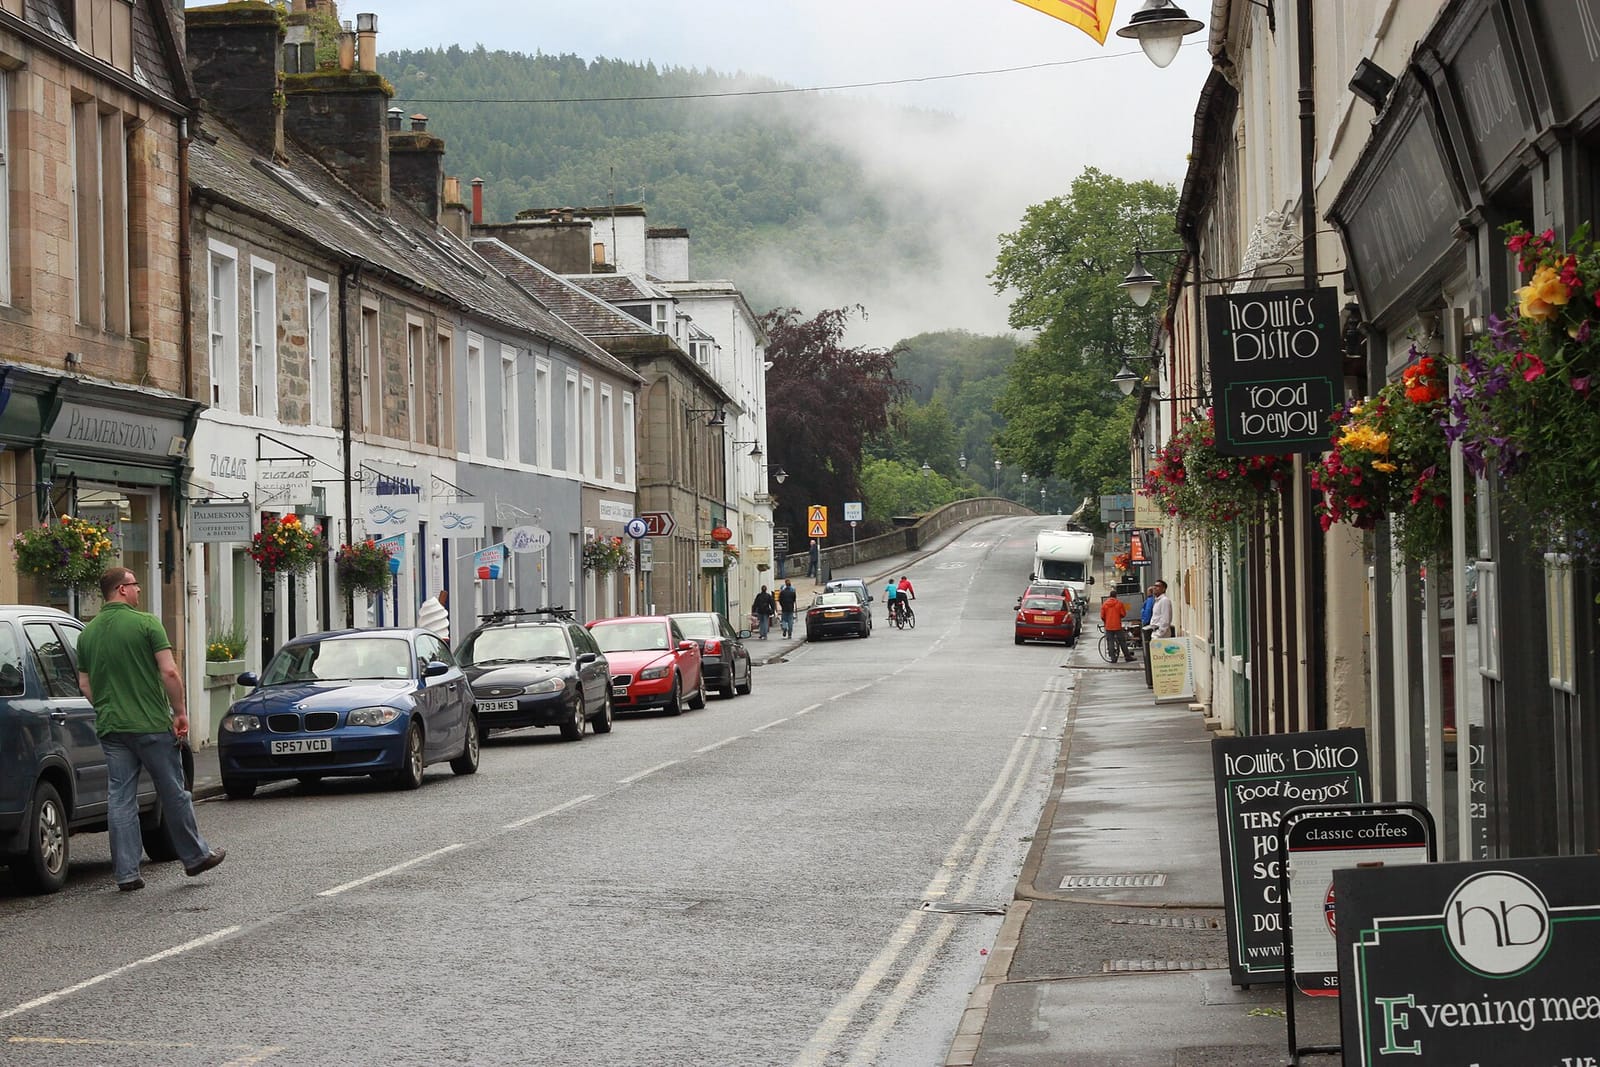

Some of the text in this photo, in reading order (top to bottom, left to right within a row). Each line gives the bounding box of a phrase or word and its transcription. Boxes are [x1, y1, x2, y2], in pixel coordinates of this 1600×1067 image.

[66, 408, 157, 450] PALMERSTON'S
[210, 454, 247, 480] ZIGZAGS
[262, 471, 309, 480] ZIGZAGS
[193, 511, 250, 520] PALMERSTON'S
[498, 701, 514, 710] MES
[275, 739, 327, 753] SP57 VCD
[1240, 811, 1281, 829] TEAS
[1305, 822, 1408, 841] classic coffees
[1374, 993, 1537, 1056] Evening
